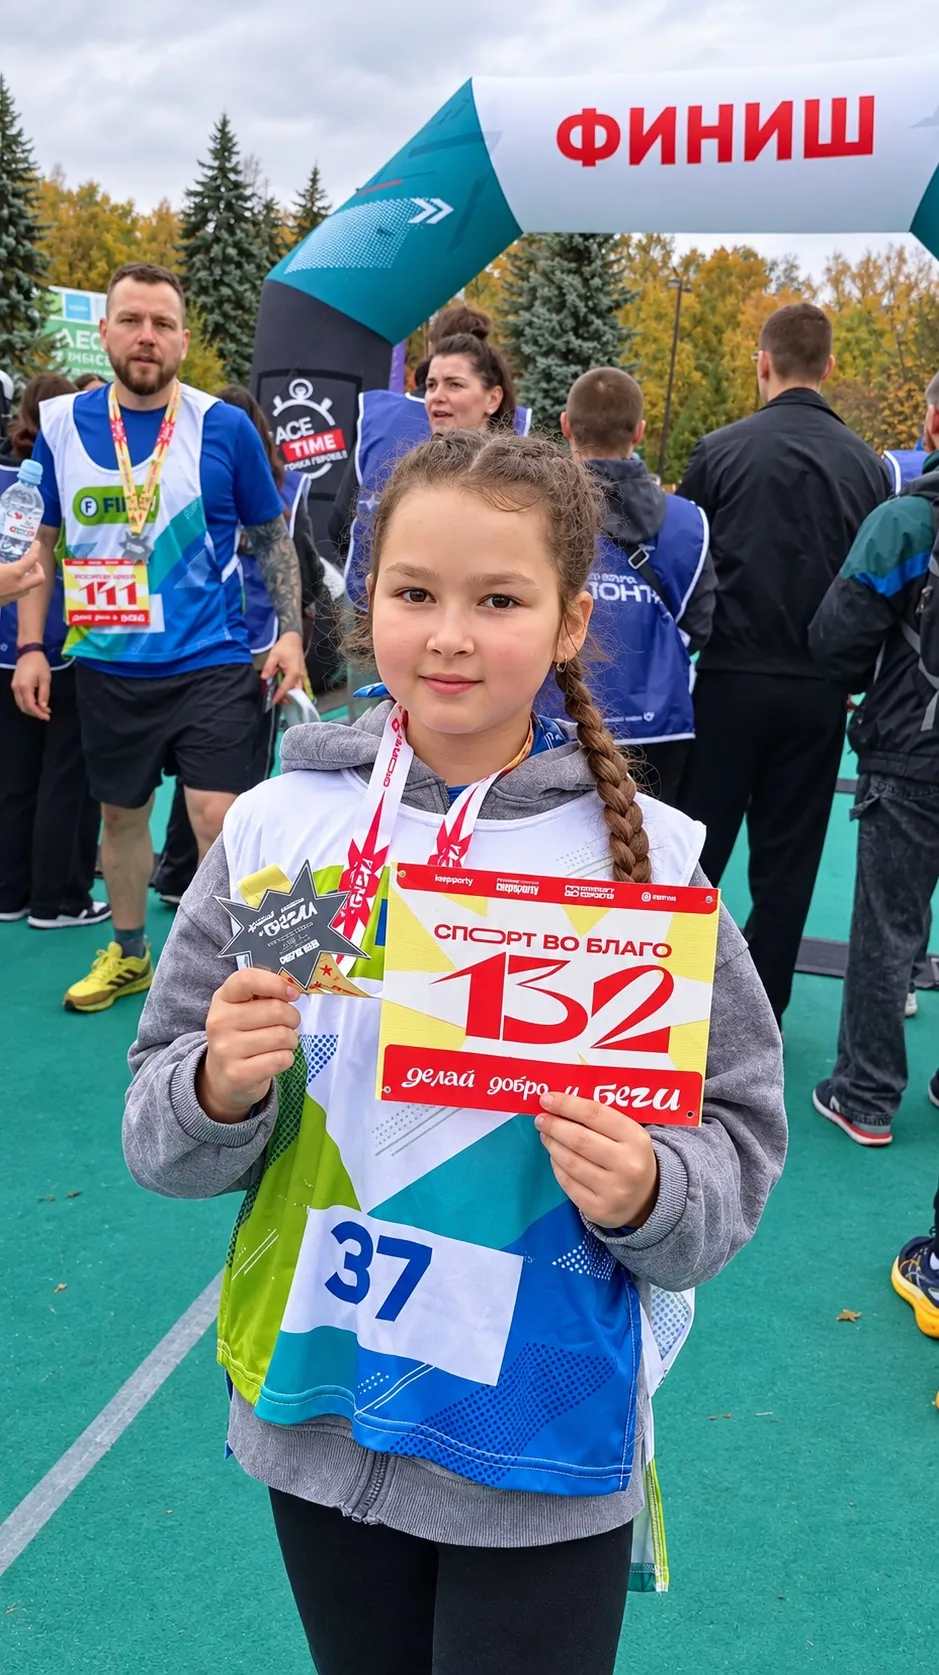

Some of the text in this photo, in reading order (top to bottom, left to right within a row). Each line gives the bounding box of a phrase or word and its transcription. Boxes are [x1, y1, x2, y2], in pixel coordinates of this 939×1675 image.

[556, 95, 875, 168] ФИНИШ
[289, 434, 337, 458] TIME
[434, 923, 673, 958] СПОРТ ВО БЛАГО
[429, 951, 675, 1054] 132
[401, 1067, 476, 1088] делай
[487, 1076, 549, 1100] добро
[324, 1220, 433, 1322] 37
